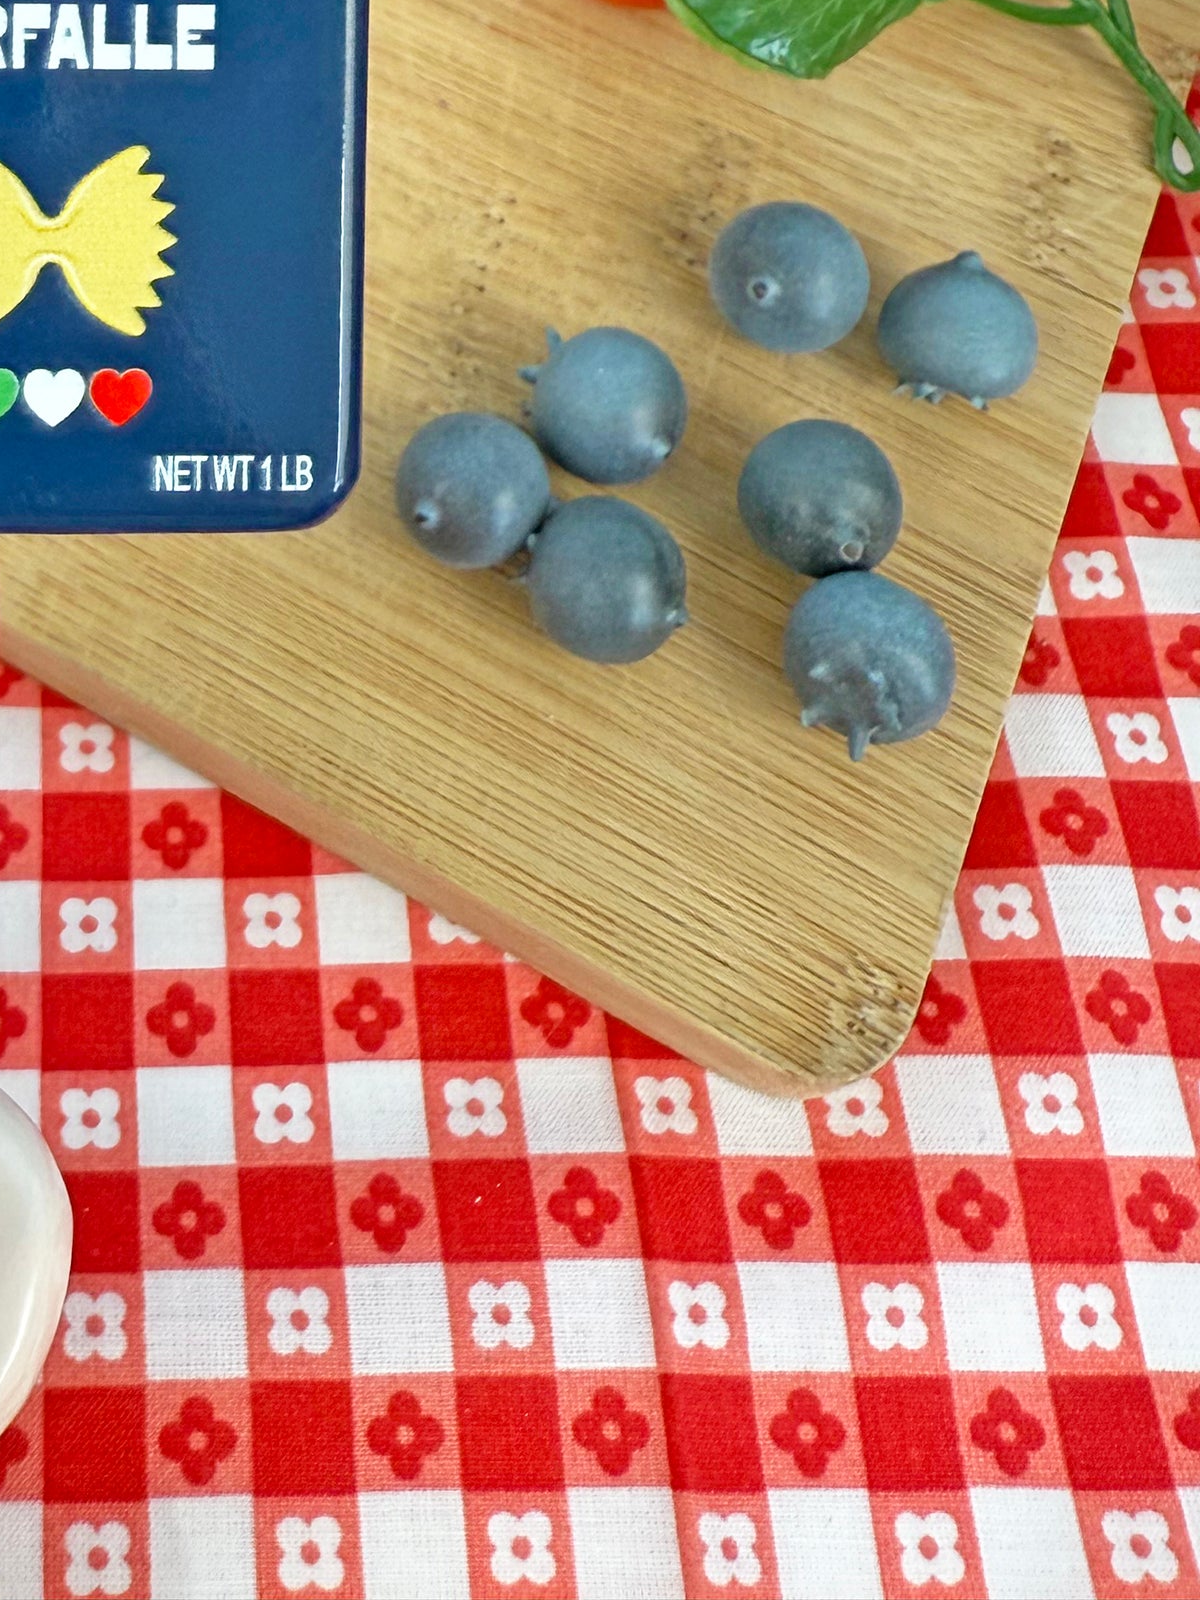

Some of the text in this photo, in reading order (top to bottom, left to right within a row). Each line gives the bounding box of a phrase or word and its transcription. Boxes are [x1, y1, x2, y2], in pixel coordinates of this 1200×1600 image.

[152, 453, 315, 493] NET WT 1 LB
